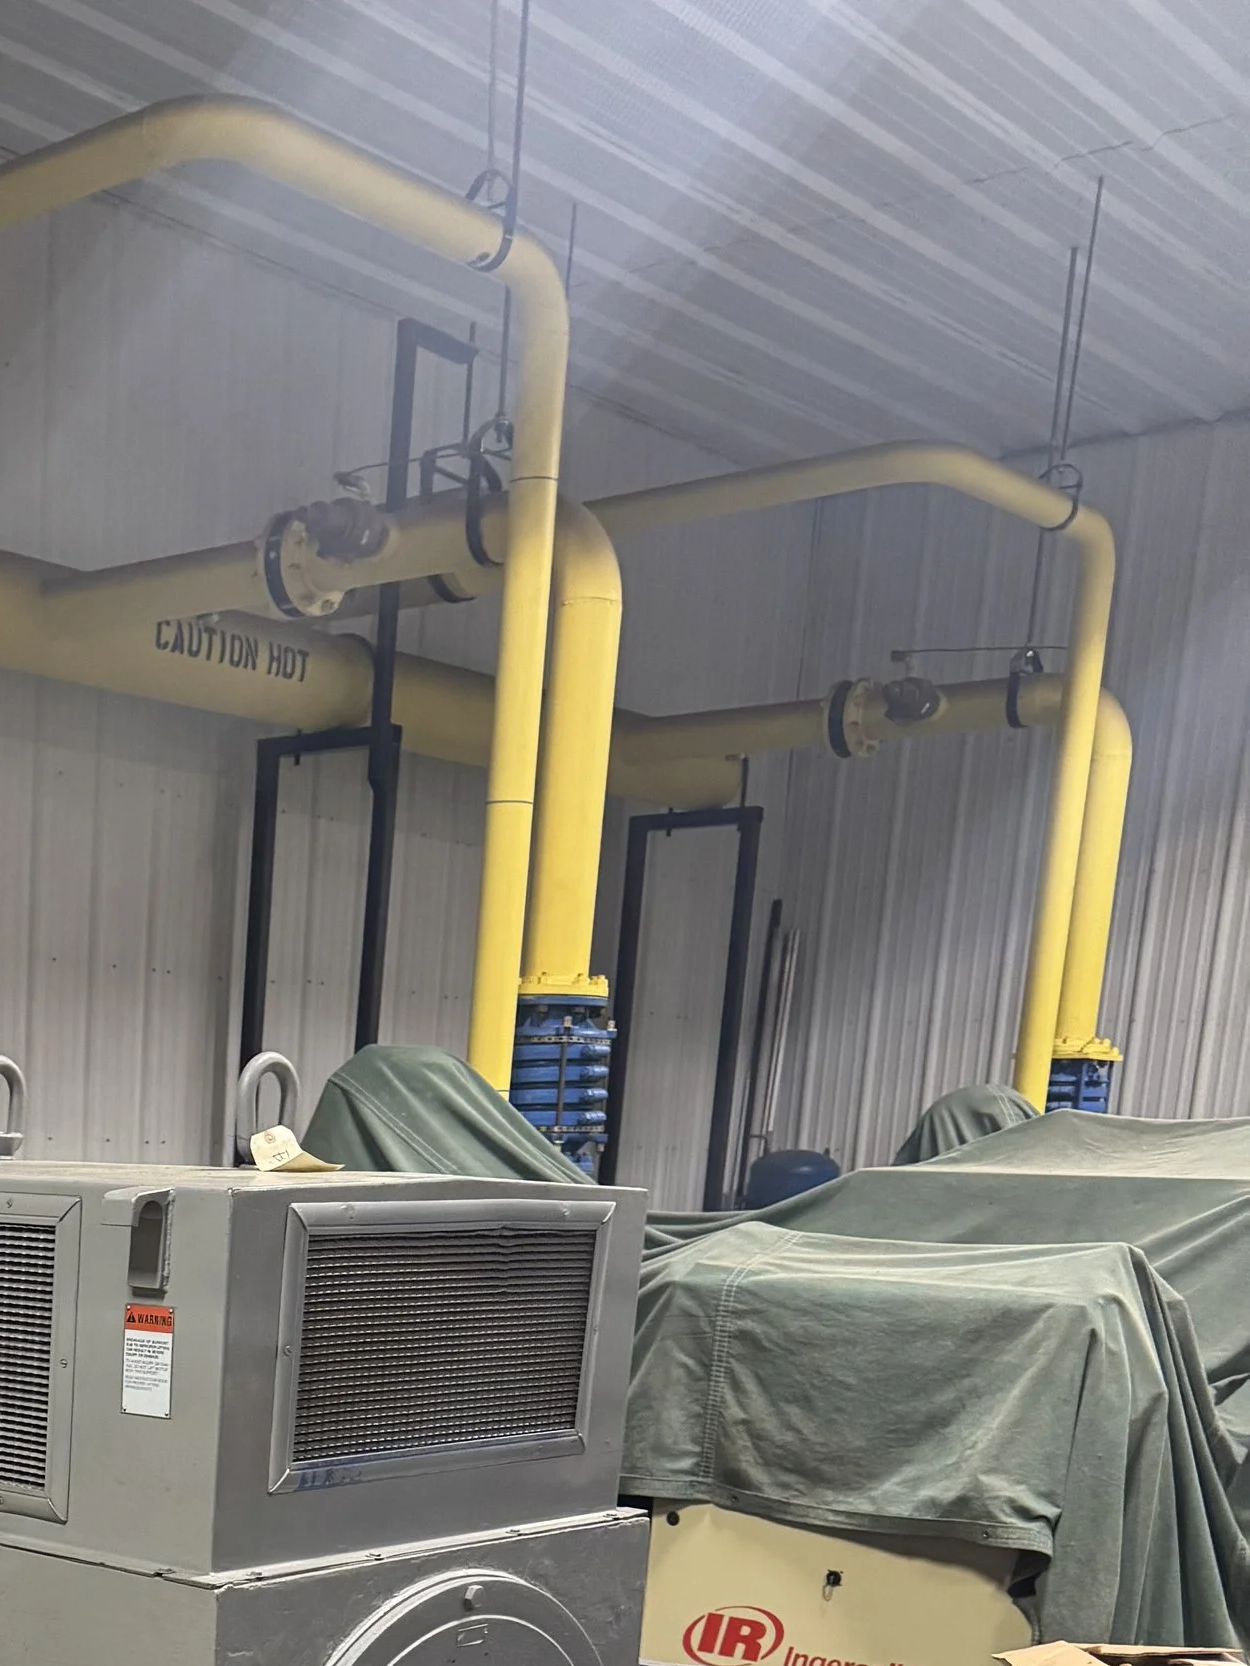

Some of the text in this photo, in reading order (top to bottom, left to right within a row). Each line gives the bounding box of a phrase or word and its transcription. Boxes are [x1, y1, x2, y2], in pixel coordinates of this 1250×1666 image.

[154, 618, 311, 683] CAUTION HOT
[137, 1313, 173, 1327] WARNING
[698, 1610, 768, 1663] IR
